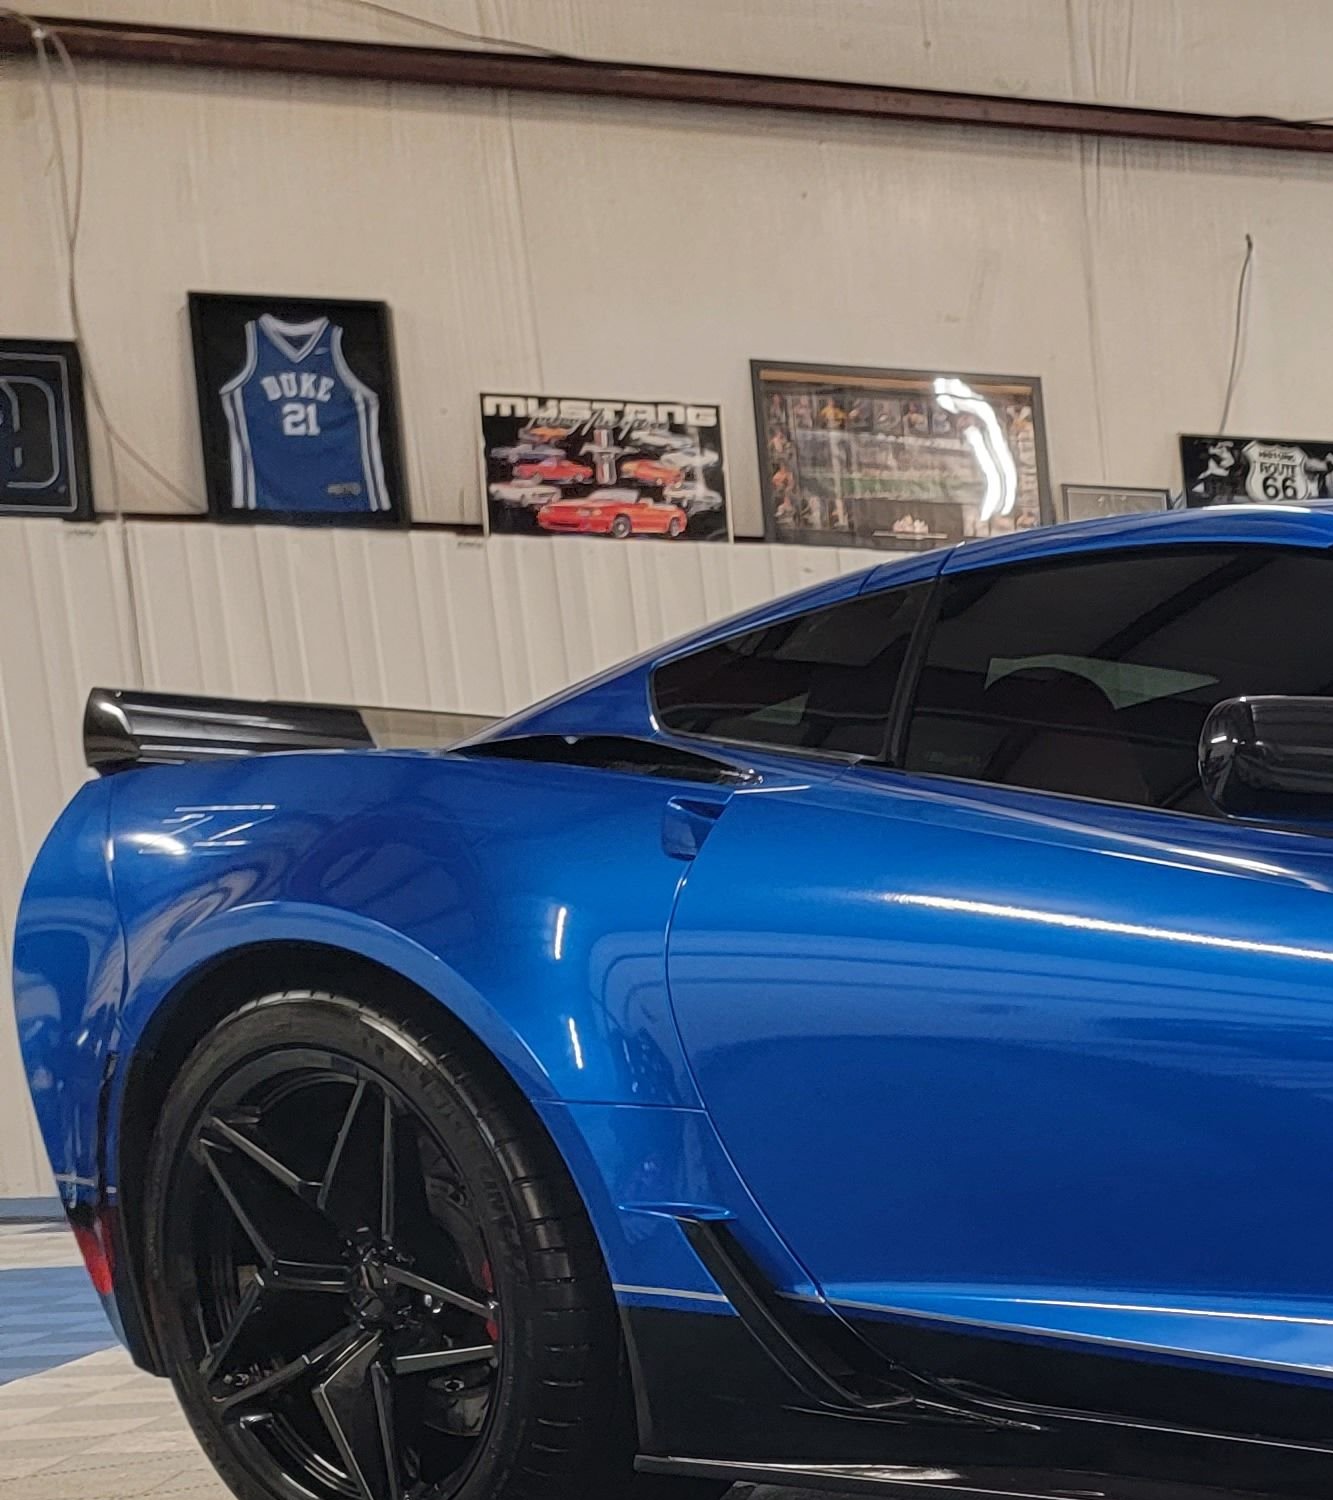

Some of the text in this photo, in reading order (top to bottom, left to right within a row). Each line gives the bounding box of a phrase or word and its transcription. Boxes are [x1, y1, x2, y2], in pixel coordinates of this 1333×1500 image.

[261, 372, 335, 402] DUKE
[282, 402, 321, 436] 21
[483, 396, 718, 427] MUSTANG
[1260, 462, 1298, 477] ROUTE
[1262, 476, 1297, 500] 66
